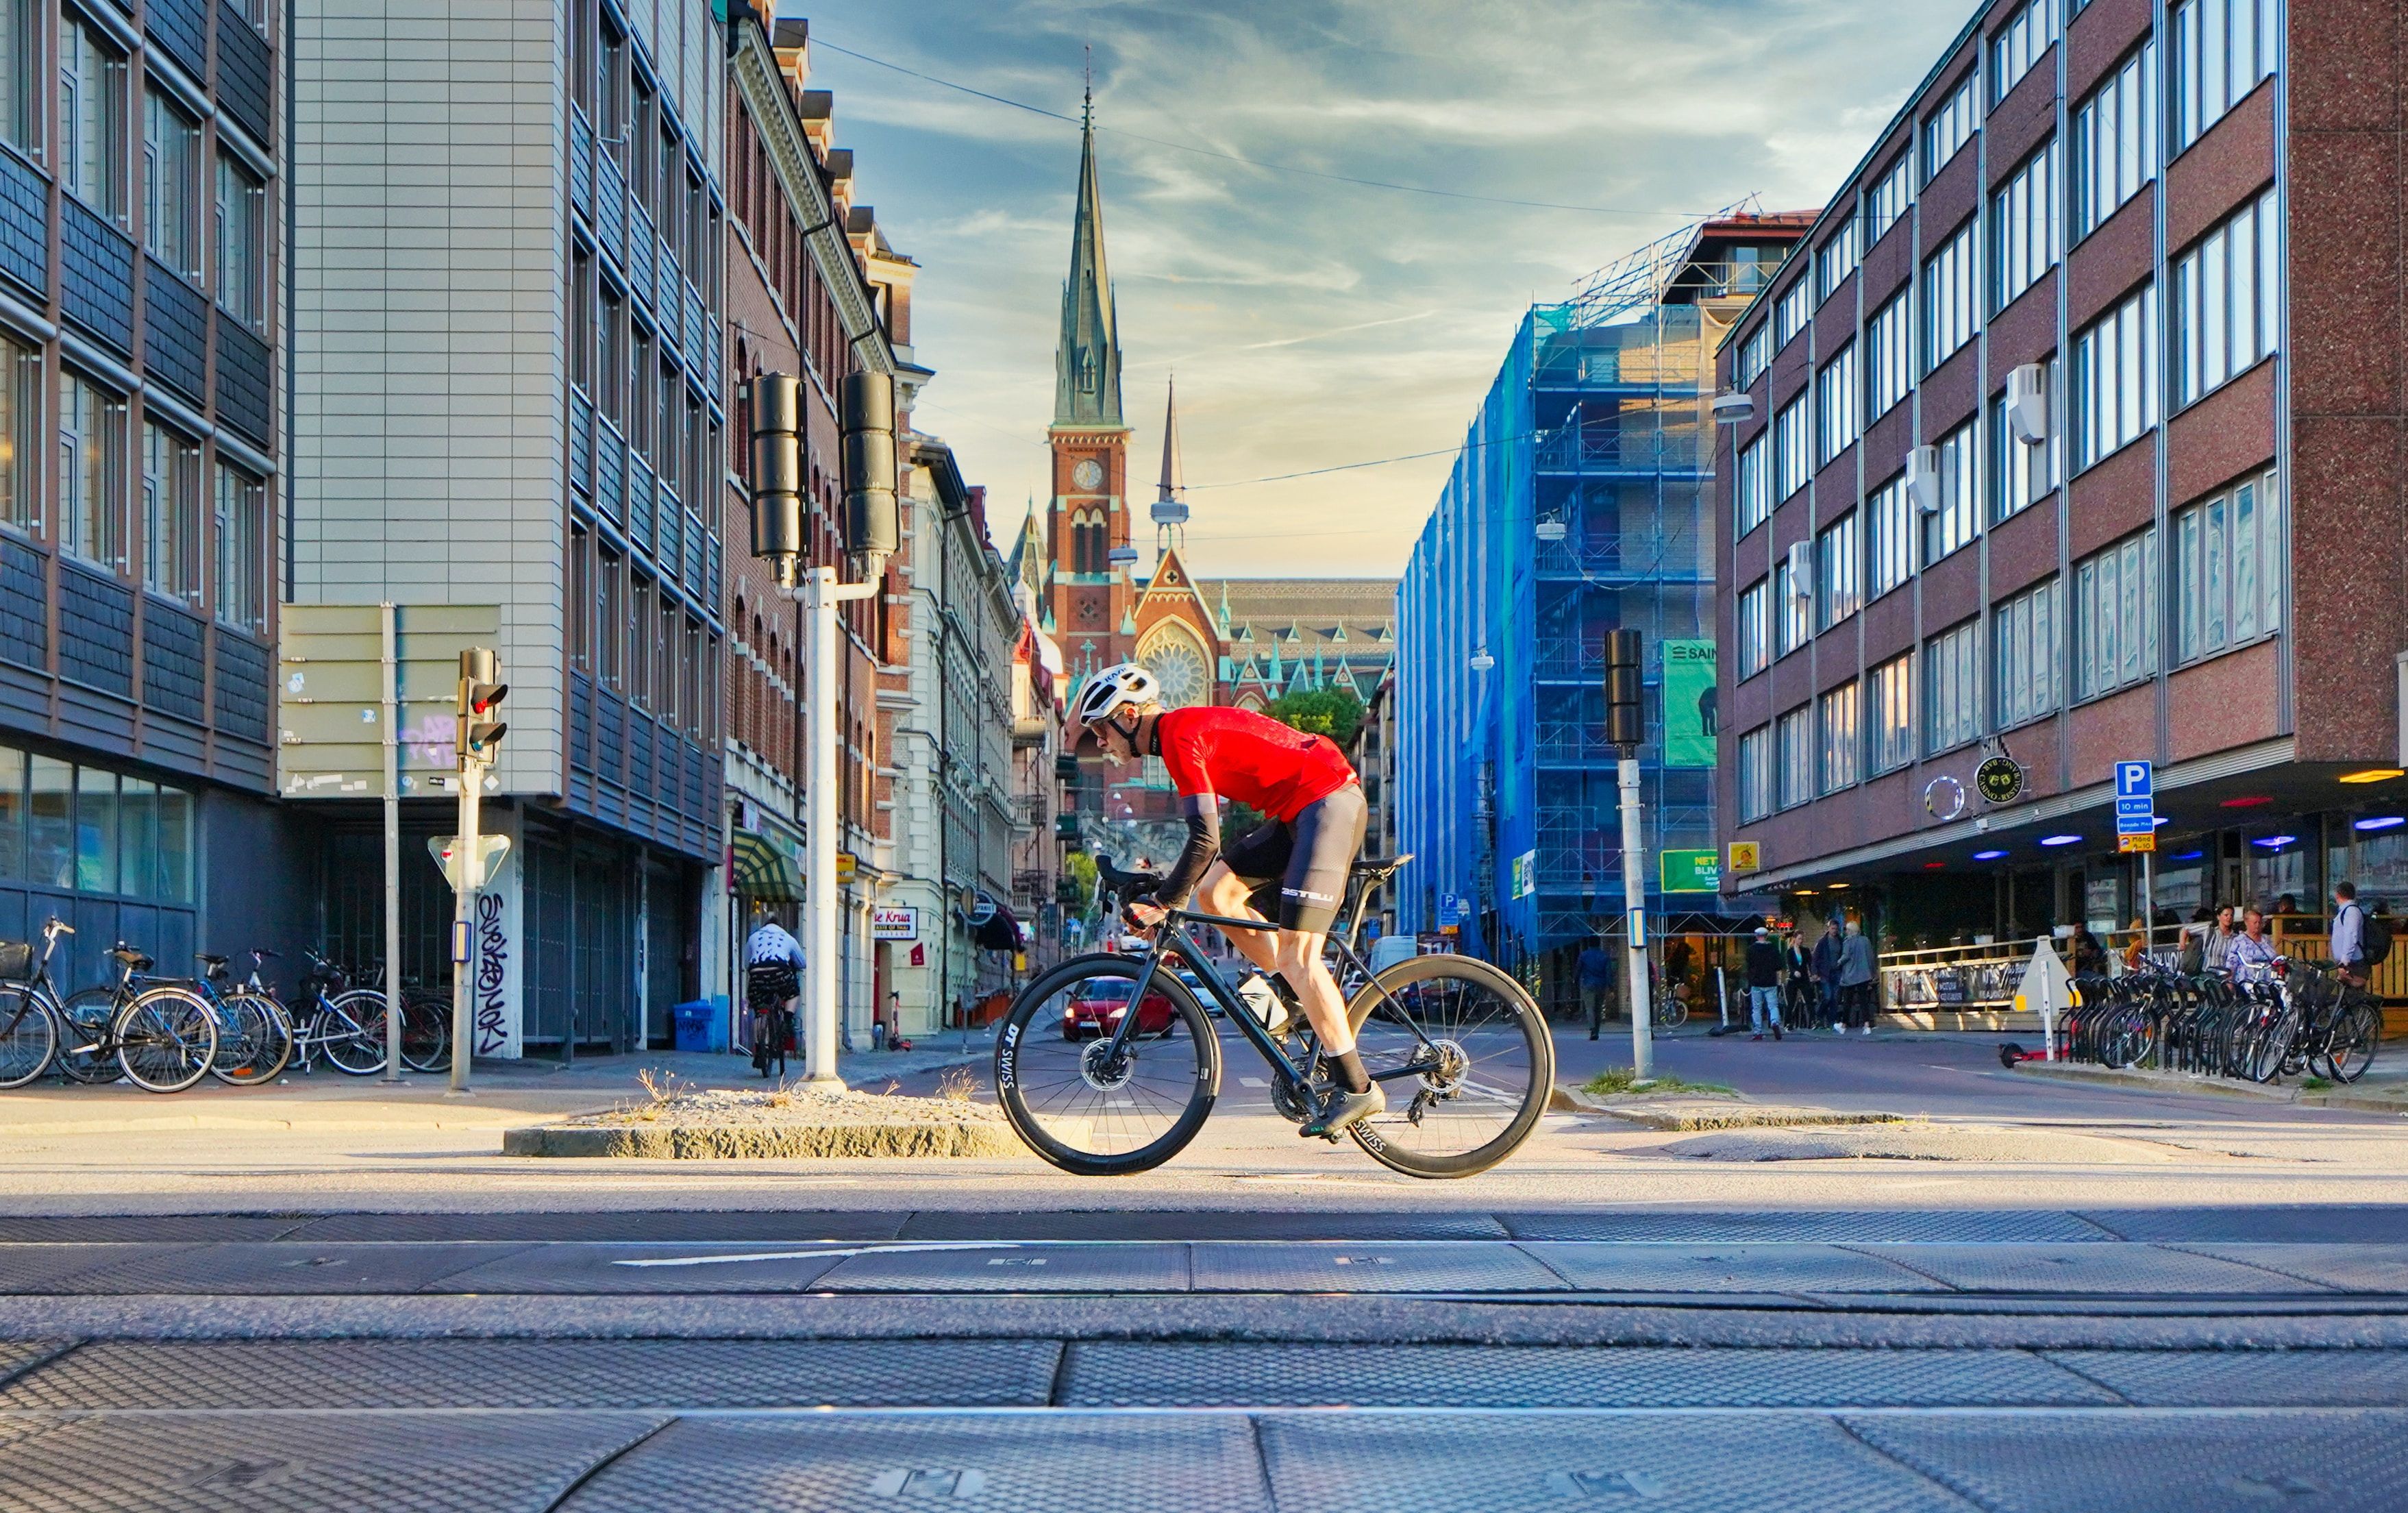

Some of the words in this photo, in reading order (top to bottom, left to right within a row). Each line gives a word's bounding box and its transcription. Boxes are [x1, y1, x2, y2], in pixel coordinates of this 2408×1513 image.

[1983, 759, 1998, 772] BAR
[1978, 774, 1998, 800] CASINO
[2001, 759, 2021, 800] RESTAURANG
[2125, 765, 2145, 794] P
[1446, 895, 1454, 907] P
[886, 911, 910, 922] Krua
[1005, 1023, 1019, 1047] DT
[1002, 1049, 1014, 1089] SWISS
[1354, 1120, 1387, 1152] SWISS
